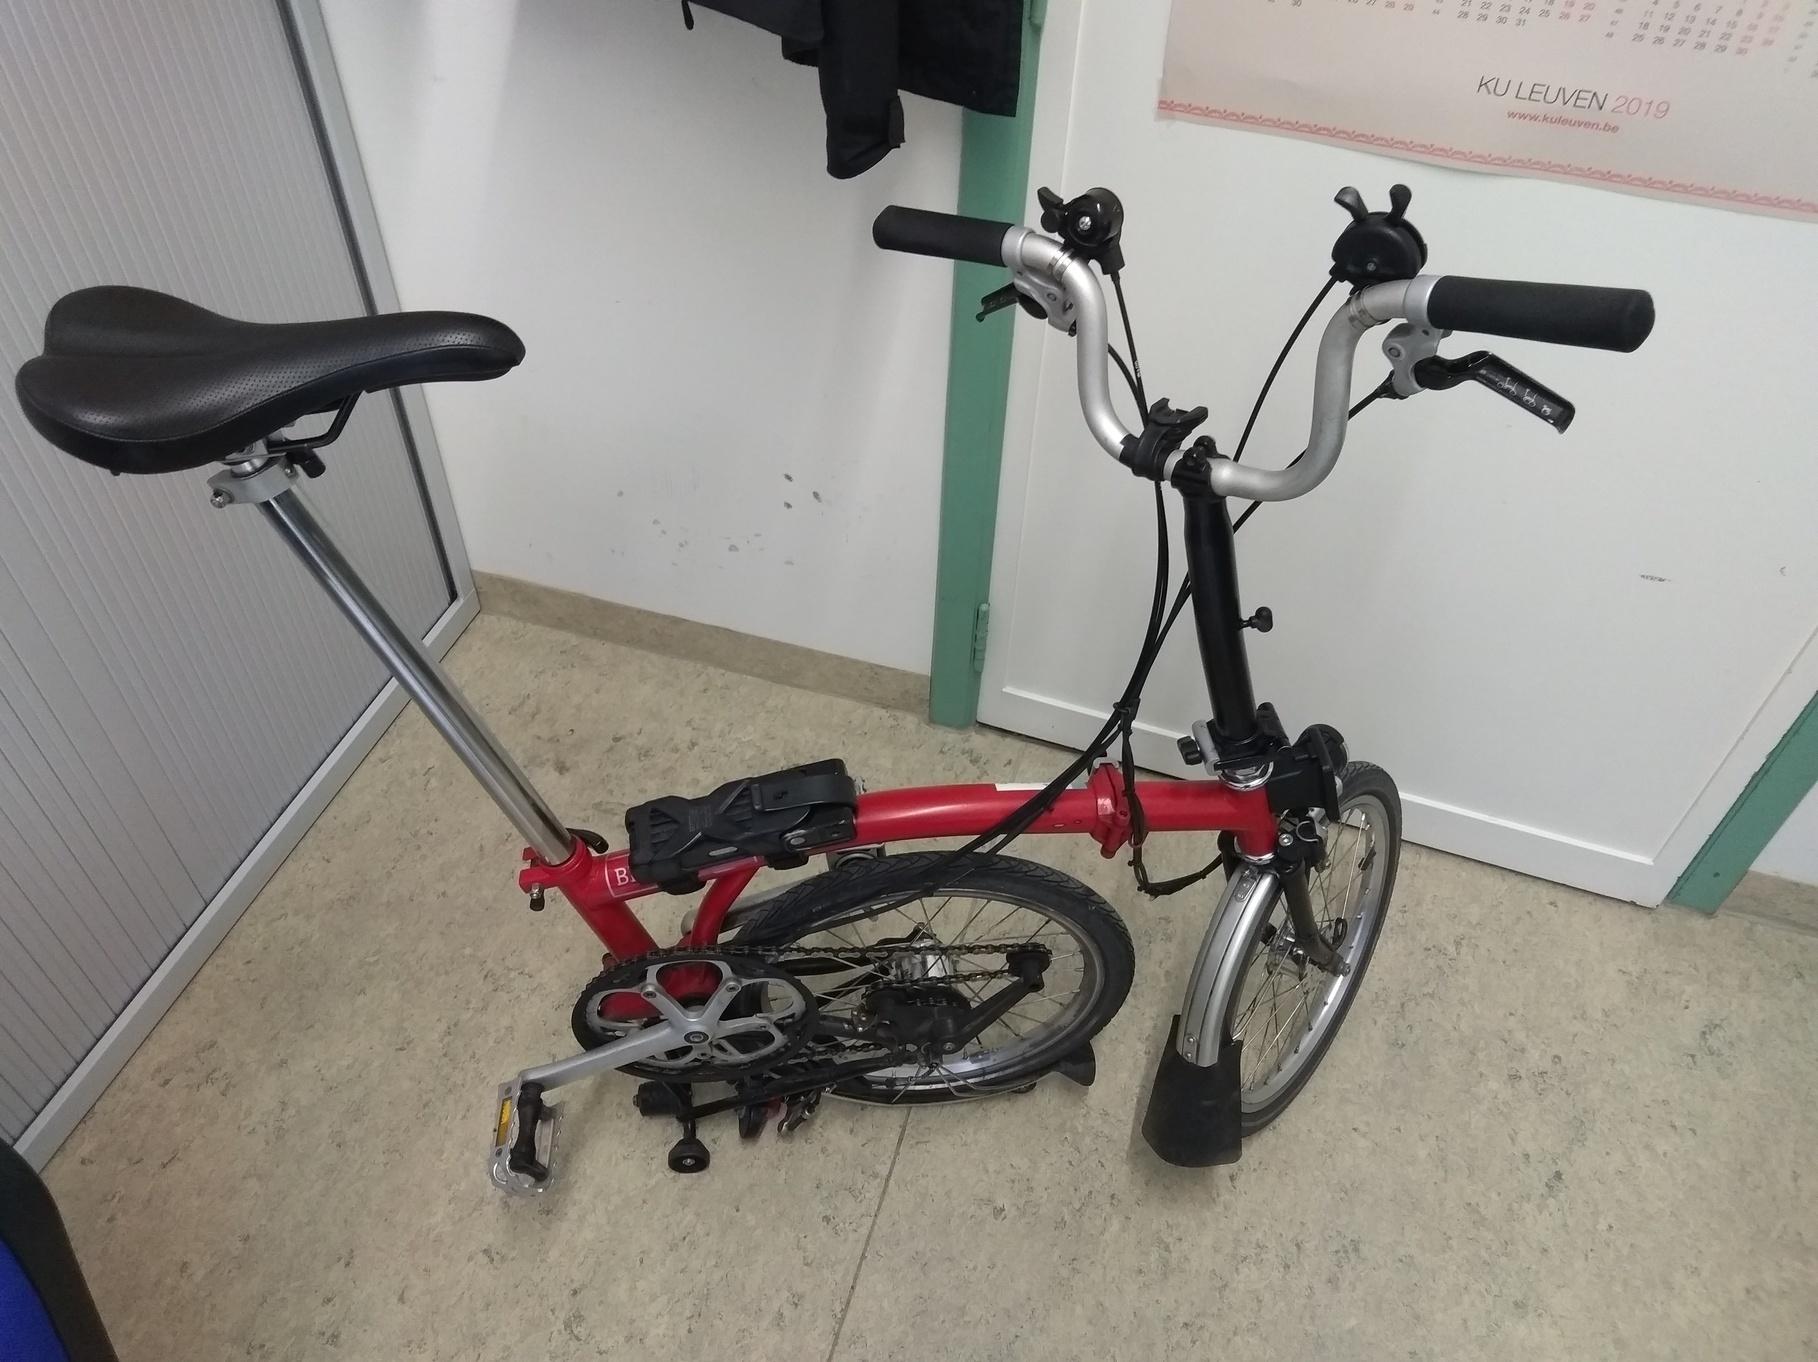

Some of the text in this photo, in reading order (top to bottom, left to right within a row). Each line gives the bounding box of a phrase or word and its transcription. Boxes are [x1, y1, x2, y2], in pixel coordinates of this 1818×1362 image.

[1480, 1, 1492, 10] 22
[1499, 4, 1511, 13] 23
[1519, 7, 1531, 15] 24
[1538, 9, 1550, 18] 25
[1715, 5, 1723, 14] 7
[1477, 13, 1488, 22] 29
[1496, 16, 1508, 24] 30
[1516, 18, 1526, 26] 31
[1664, 12, 1675, 21] 12
[1706, 17, 1717, 26] 14
[1639, 21, 1650, 31] 18
[1659, 24, 1671, 33] 19
[1698, 29, 1711, 38] 21
[1720, 32, 1733, 41] 22
[1632, 33, 1645, 42] 25
[1652, 36, 1665, 45] 26
[1672, 38, 1686, 47] 27
[1694, 41, 1707, 50] 28
[1714, 44, 1728, 53] 29
[1476, 75, 1671, 119] KU LEUVEN 2019
[1507, 110, 1619, 133] www.kuleuven.be
